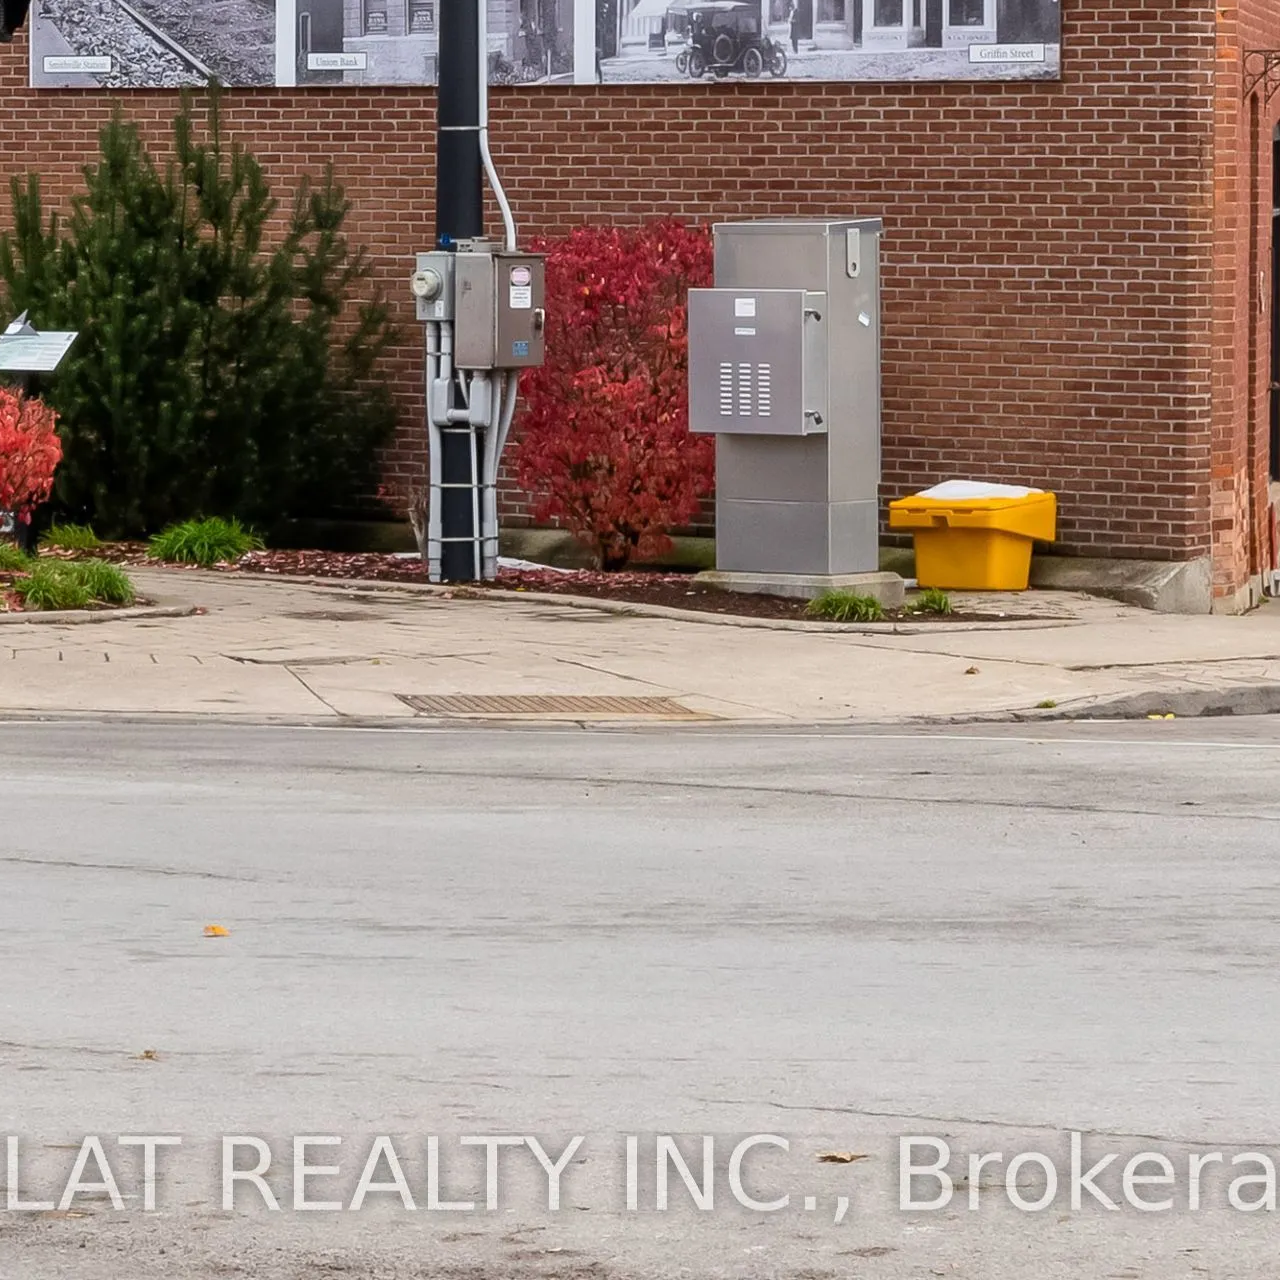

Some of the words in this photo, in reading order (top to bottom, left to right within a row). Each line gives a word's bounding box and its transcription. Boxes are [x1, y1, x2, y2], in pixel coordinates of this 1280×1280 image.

[980, 47, 1008, 58] Griffin
[1010, 49, 1034, 58] Street
[315, 56, 338, 66] Union
[340, 55, 359, 66] Bank
